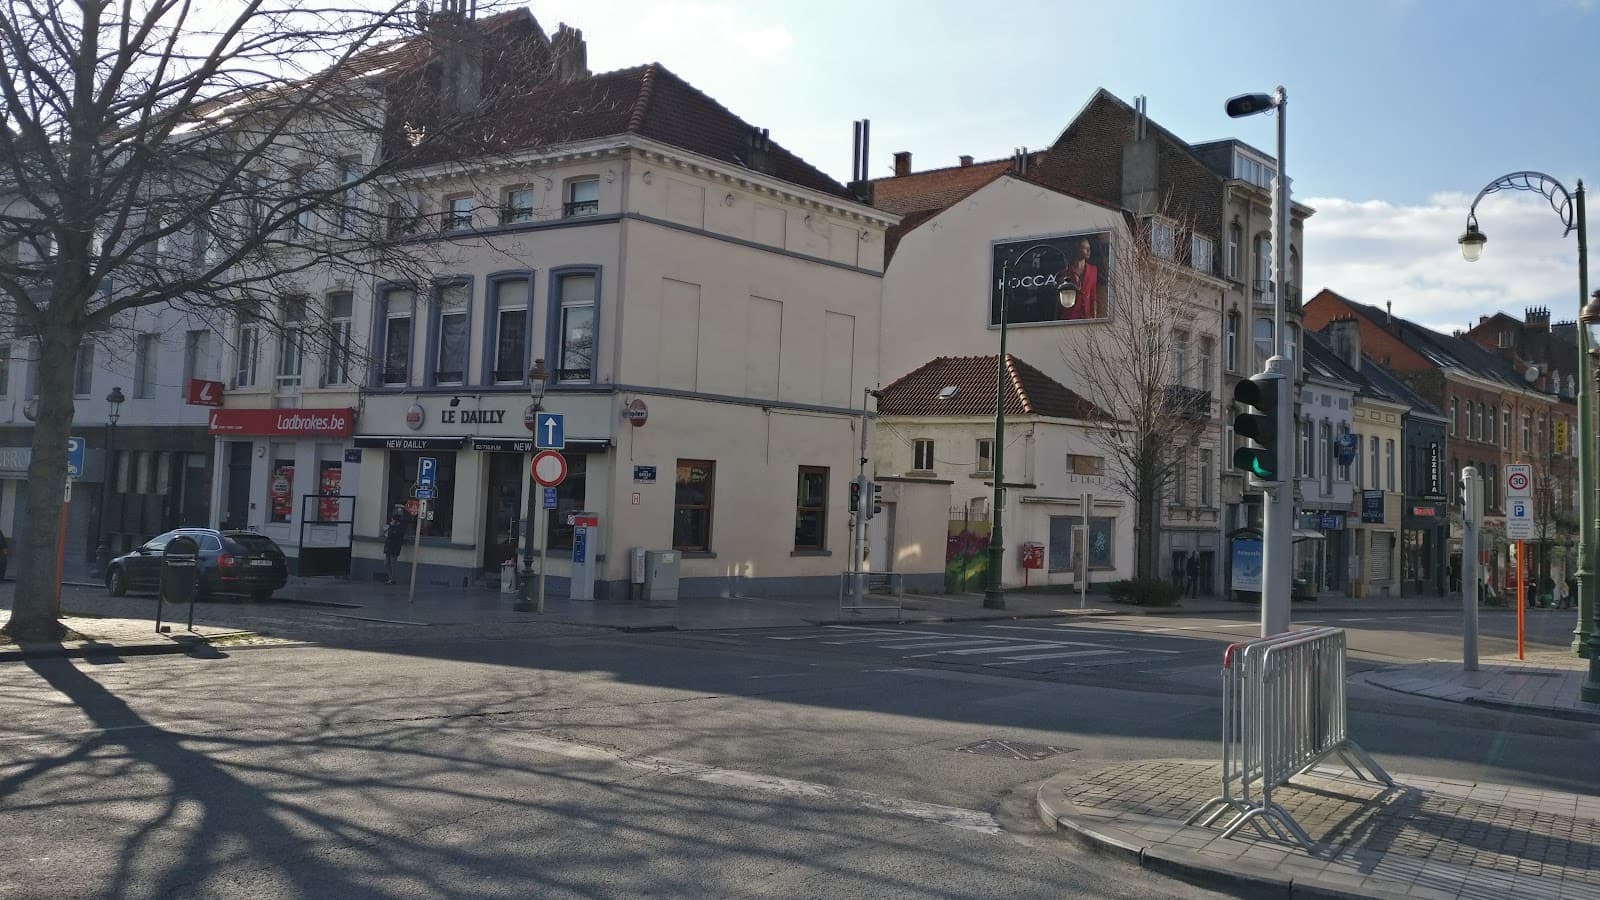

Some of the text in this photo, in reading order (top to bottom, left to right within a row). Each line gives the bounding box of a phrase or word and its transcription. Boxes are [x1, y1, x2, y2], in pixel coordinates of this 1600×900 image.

[441, 410, 506, 424] LE DAILLY
[277, 414, 345, 431] Ladbrokes.be
[386, 441, 427, 450] NEW DAILLY
[513, 442, 532, 451] NEW
[422, 459, 433, 476] P
[1512, 477, 1524, 485] 30
[1515, 506, 1523, 516] P
